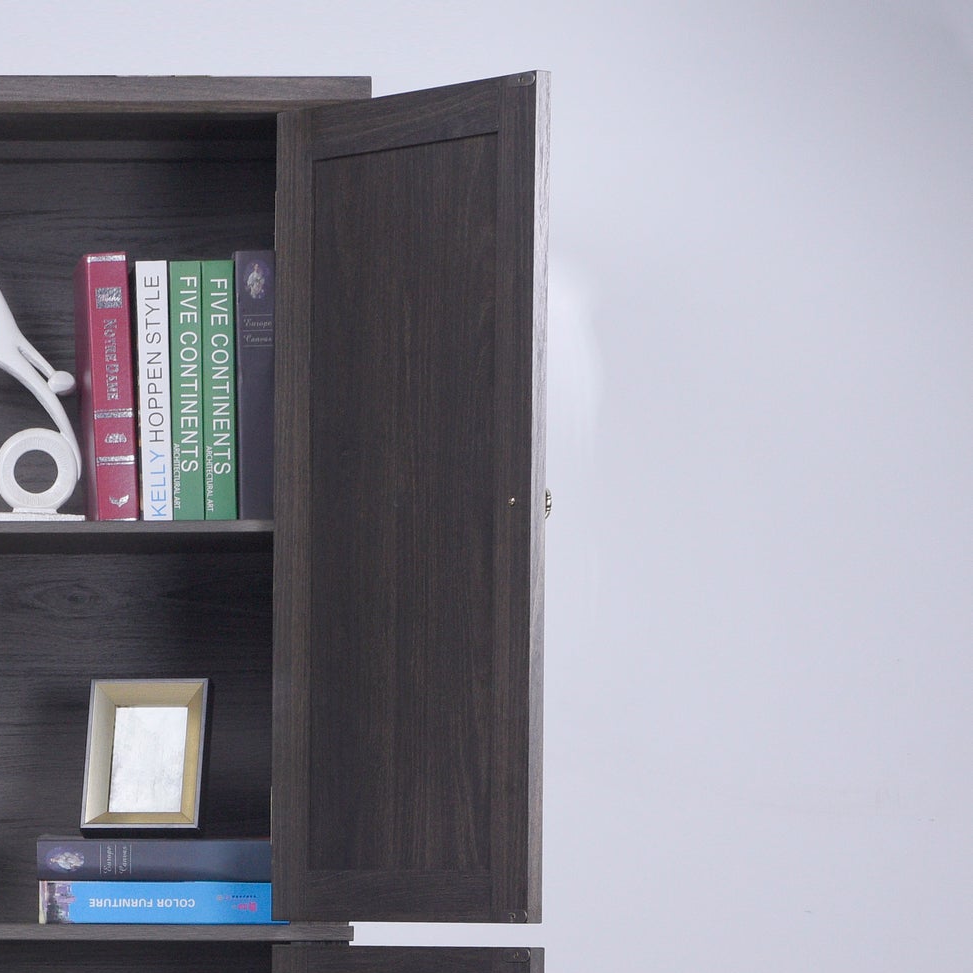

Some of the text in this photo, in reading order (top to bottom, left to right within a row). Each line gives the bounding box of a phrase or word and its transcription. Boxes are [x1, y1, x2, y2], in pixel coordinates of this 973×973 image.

[104, 318, 118, 362] NOTRE
[106, 364, 120, 400] DAME
[144, 275, 167, 517] KELLY HOPPEN STYLE
[180, 276, 198, 472] FIVE CONTINENTS
[210, 279, 231, 475] FIVE CONTINENTS
[89, 898, 196, 908] COLOR FURNITURE
